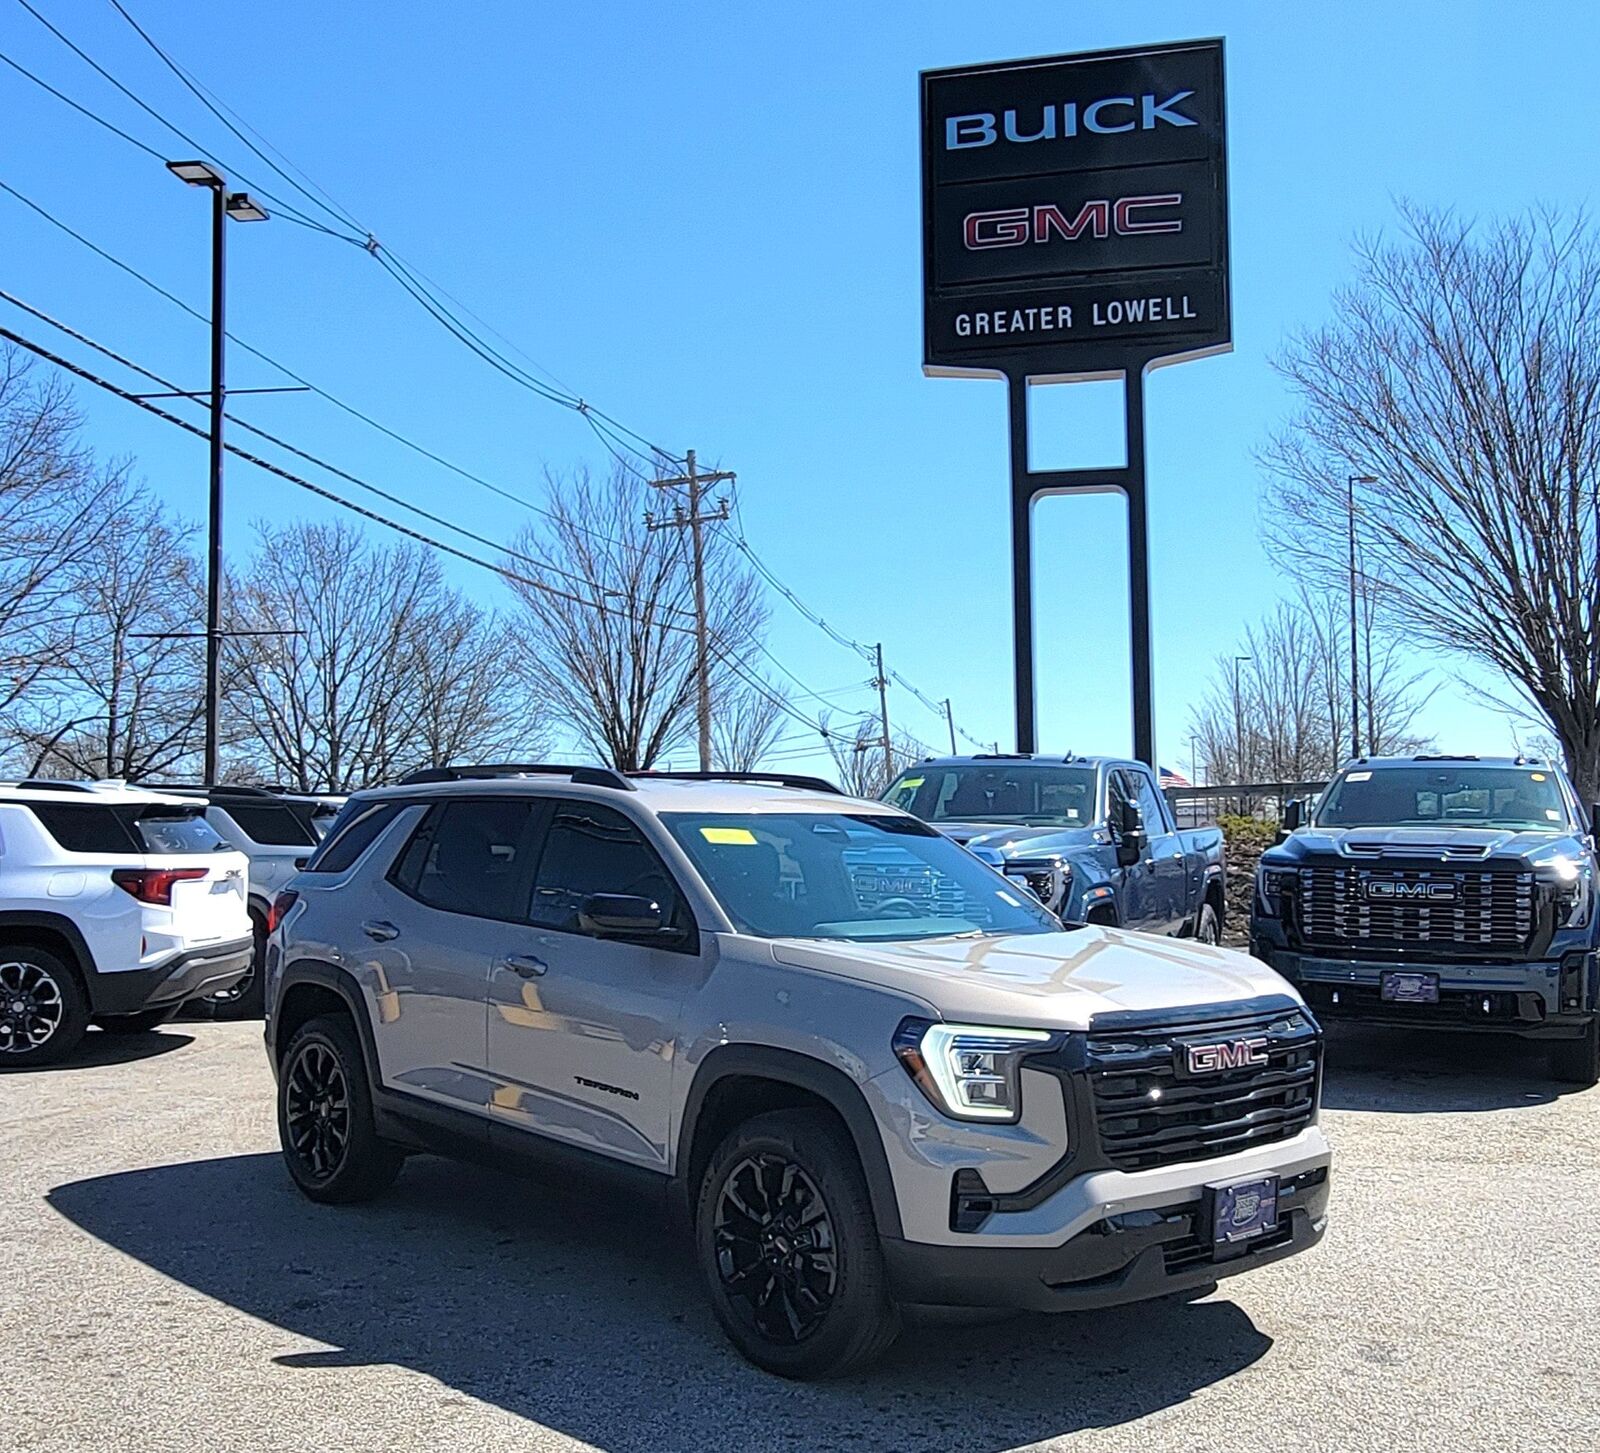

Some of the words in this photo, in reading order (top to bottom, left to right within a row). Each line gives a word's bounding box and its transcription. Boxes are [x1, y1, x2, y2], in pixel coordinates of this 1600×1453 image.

[946, 91, 1198, 150] BUICK
[964, 194, 1182, 250] GMC
[955, 306, 1073, 336] GREATER
[1092, 296, 1197, 326] LOWELL
[855, 876, 930, 893] GMC
[1368, 881, 1455, 899] GMC
[1188, 1038, 1269, 1073] GMC
